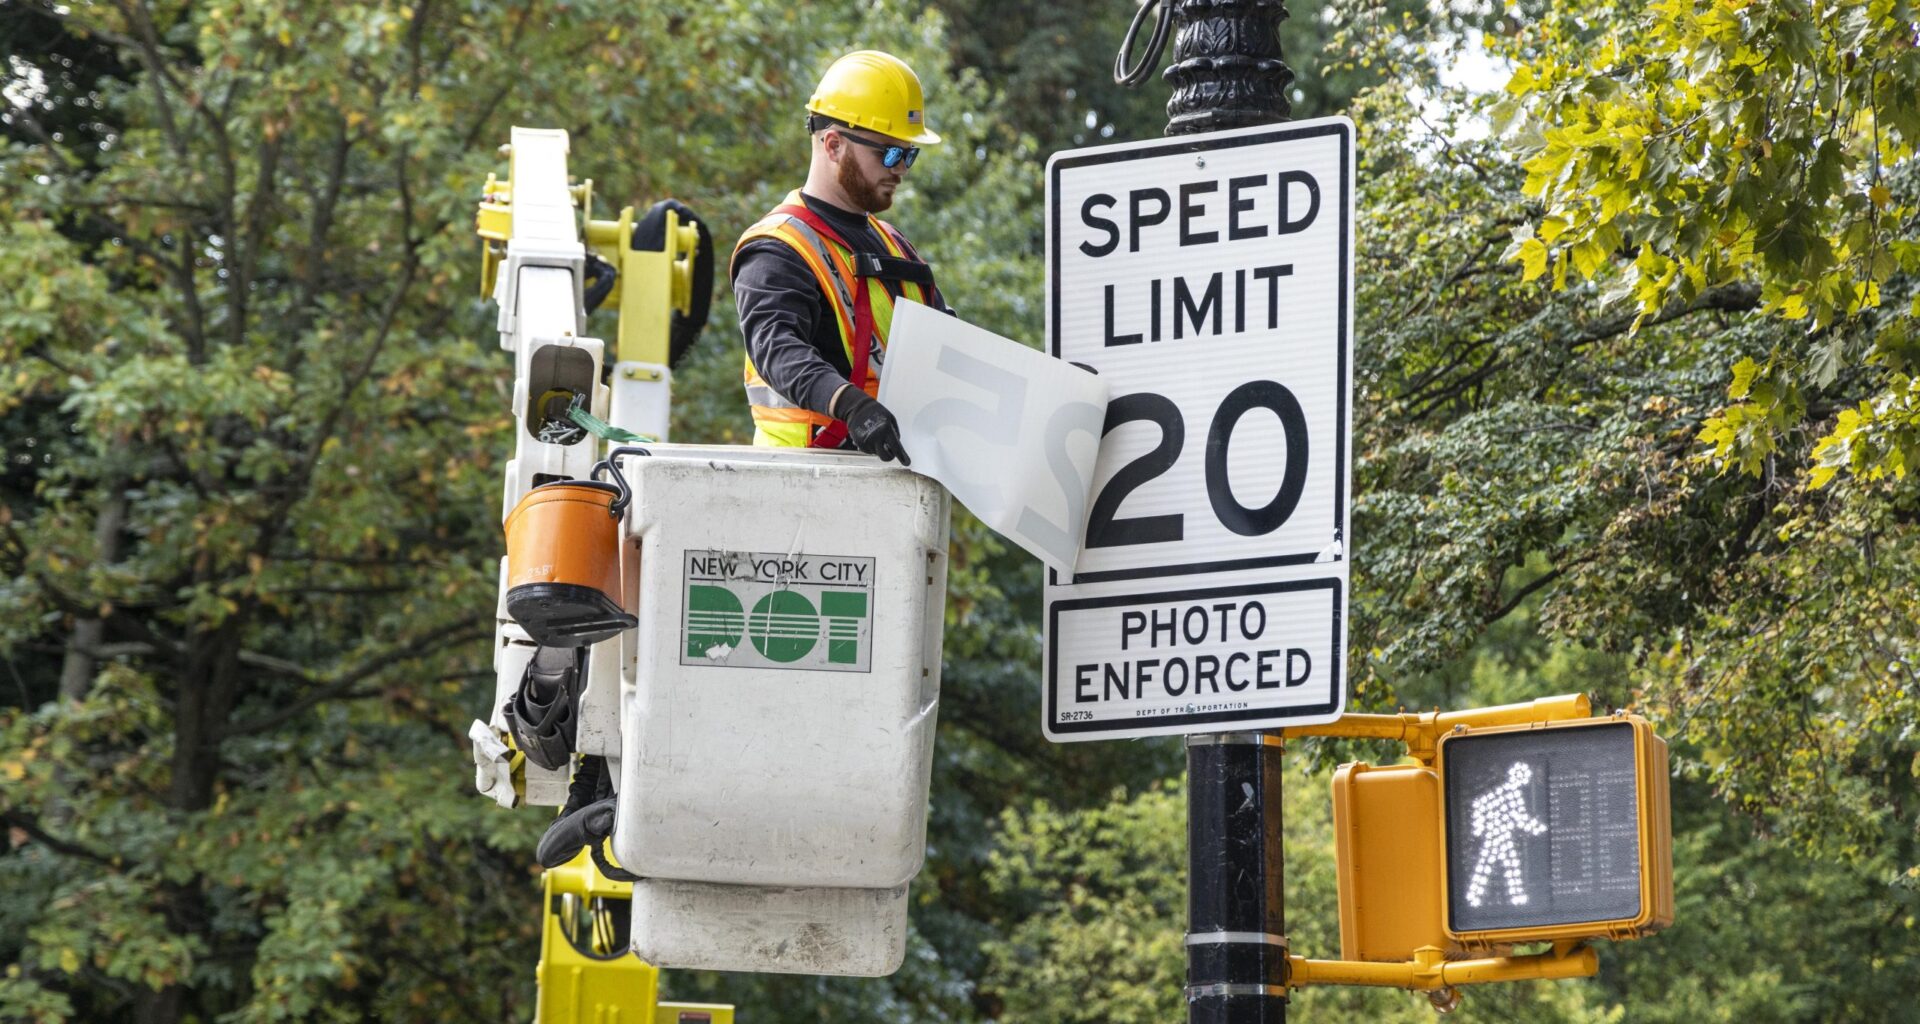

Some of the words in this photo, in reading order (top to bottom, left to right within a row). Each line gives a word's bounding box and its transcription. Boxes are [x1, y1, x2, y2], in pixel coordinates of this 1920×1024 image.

[1079, 170, 1321, 258] SPEED
[1104, 263, 1293, 347] LIMIT
[1085, 380, 1309, 549] 20
[691, 557, 738, 576] NEW
[751, 559, 808, 580] YORK
[820, 562, 867, 581] CITY
[687, 585, 867, 664] DOT
[1121, 601, 1266, 650] PHOTO
[1075, 648, 1312, 703] ENFORCED
[1060, 711, 1093, 721] SR-2736
[1175, 702, 1248, 713] TRSPORTATION
